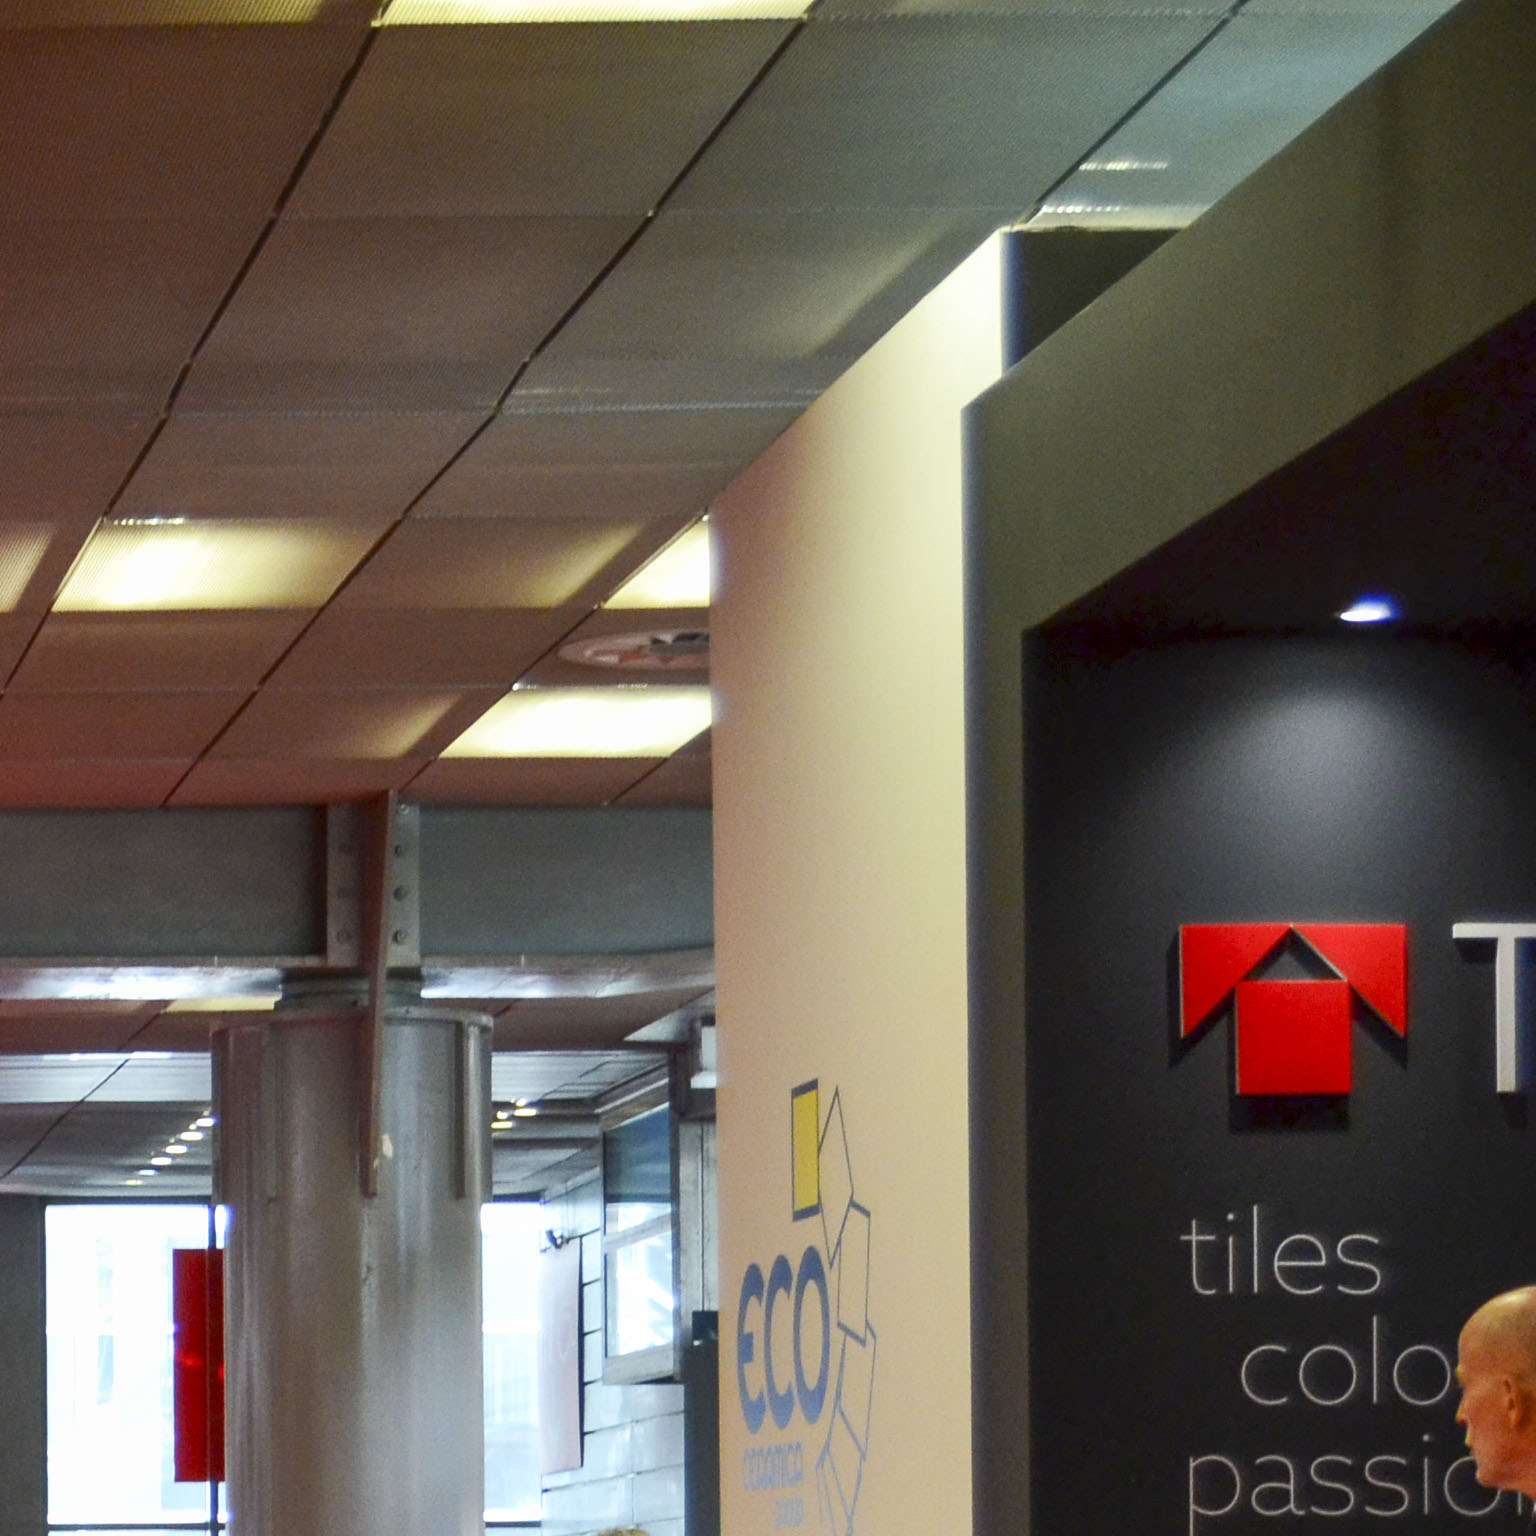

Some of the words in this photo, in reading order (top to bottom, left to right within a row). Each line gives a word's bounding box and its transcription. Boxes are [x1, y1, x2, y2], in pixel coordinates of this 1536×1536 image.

[1451, 922, 1536, 1094] T
[1180, 1204, 1382, 1294] tiles
[737, 1244, 830, 1435] ECO
[1241, 1316, 1451, 1405] colo
